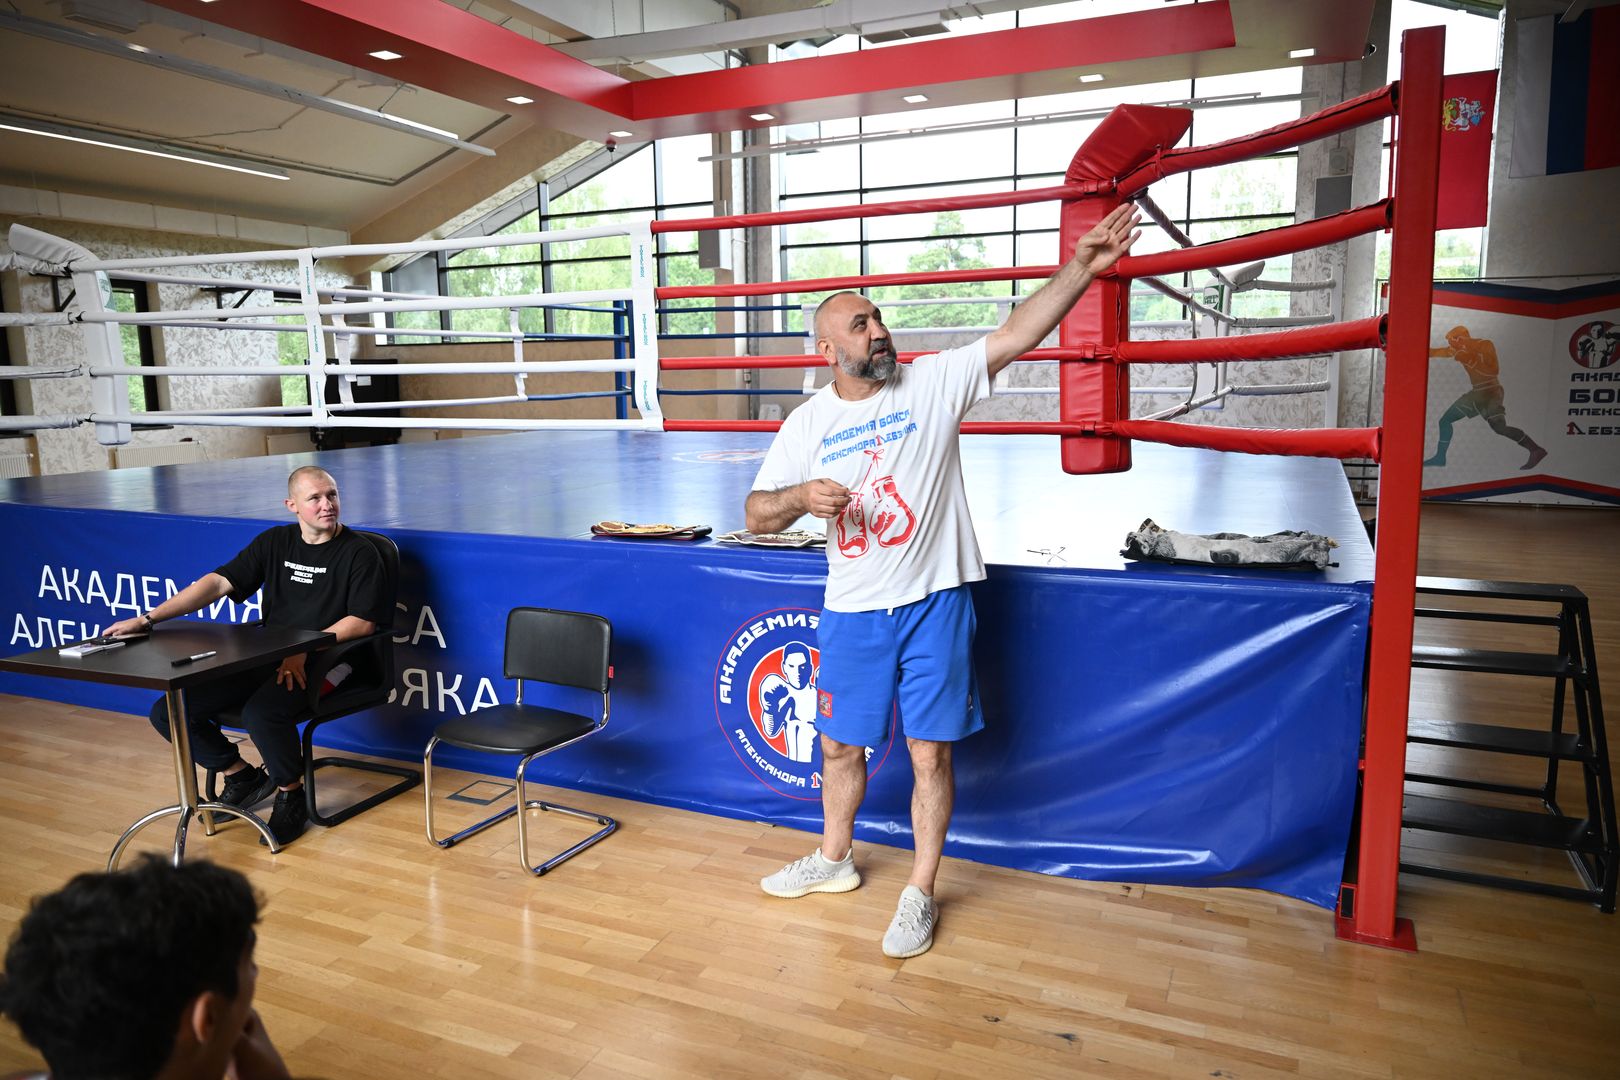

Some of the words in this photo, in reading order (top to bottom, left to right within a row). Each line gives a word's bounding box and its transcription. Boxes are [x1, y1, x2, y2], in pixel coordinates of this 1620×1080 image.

[823, 420, 876, 448] АКАДЕМИЯ
[879, 409, 910, 428] БОКСА
[719, 613, 820, 705] АКАДЕМИЯ
